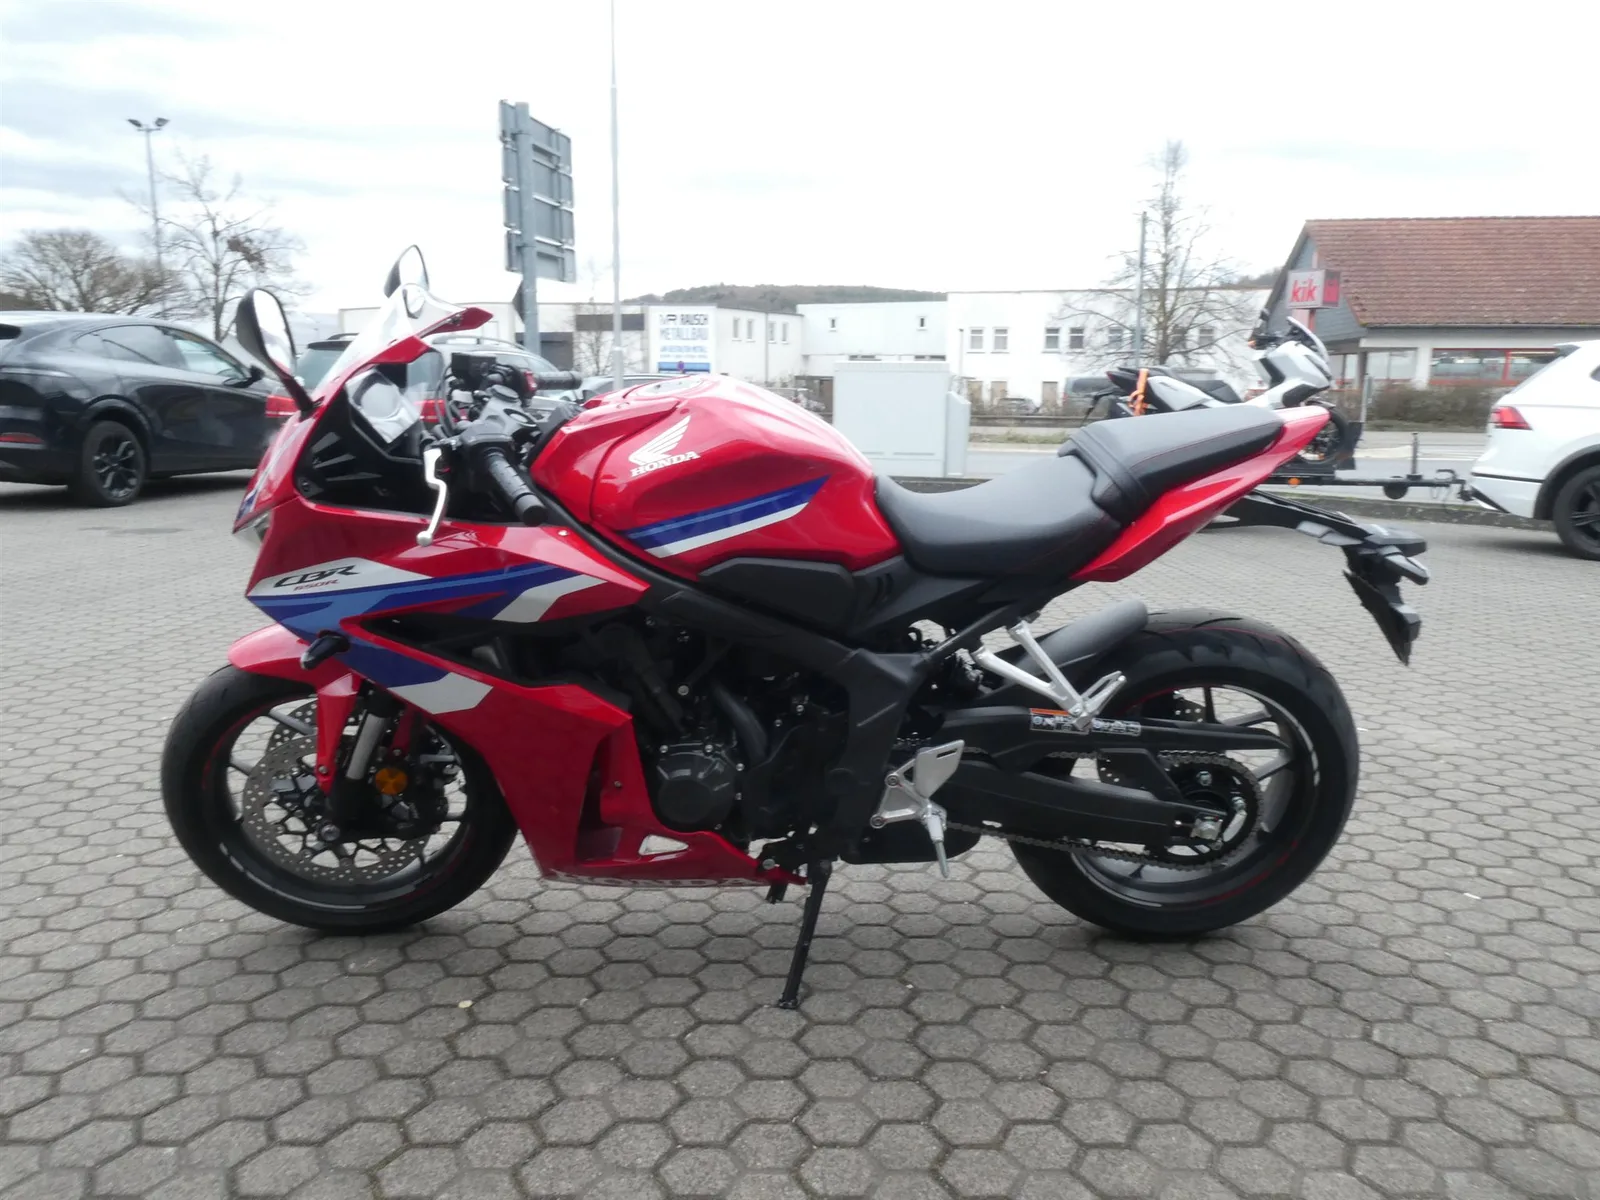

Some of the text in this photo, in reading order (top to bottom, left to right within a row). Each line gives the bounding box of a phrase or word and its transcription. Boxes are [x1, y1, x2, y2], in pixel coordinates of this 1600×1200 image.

[680, 313, 708, 325] RAUSCH
[660, 327, 708, 340] METALLBAU
[630, 451, 701, 477] HONDA
[273, 564, 359, 588] CBR
[293, 579, 340, 591] 650R
